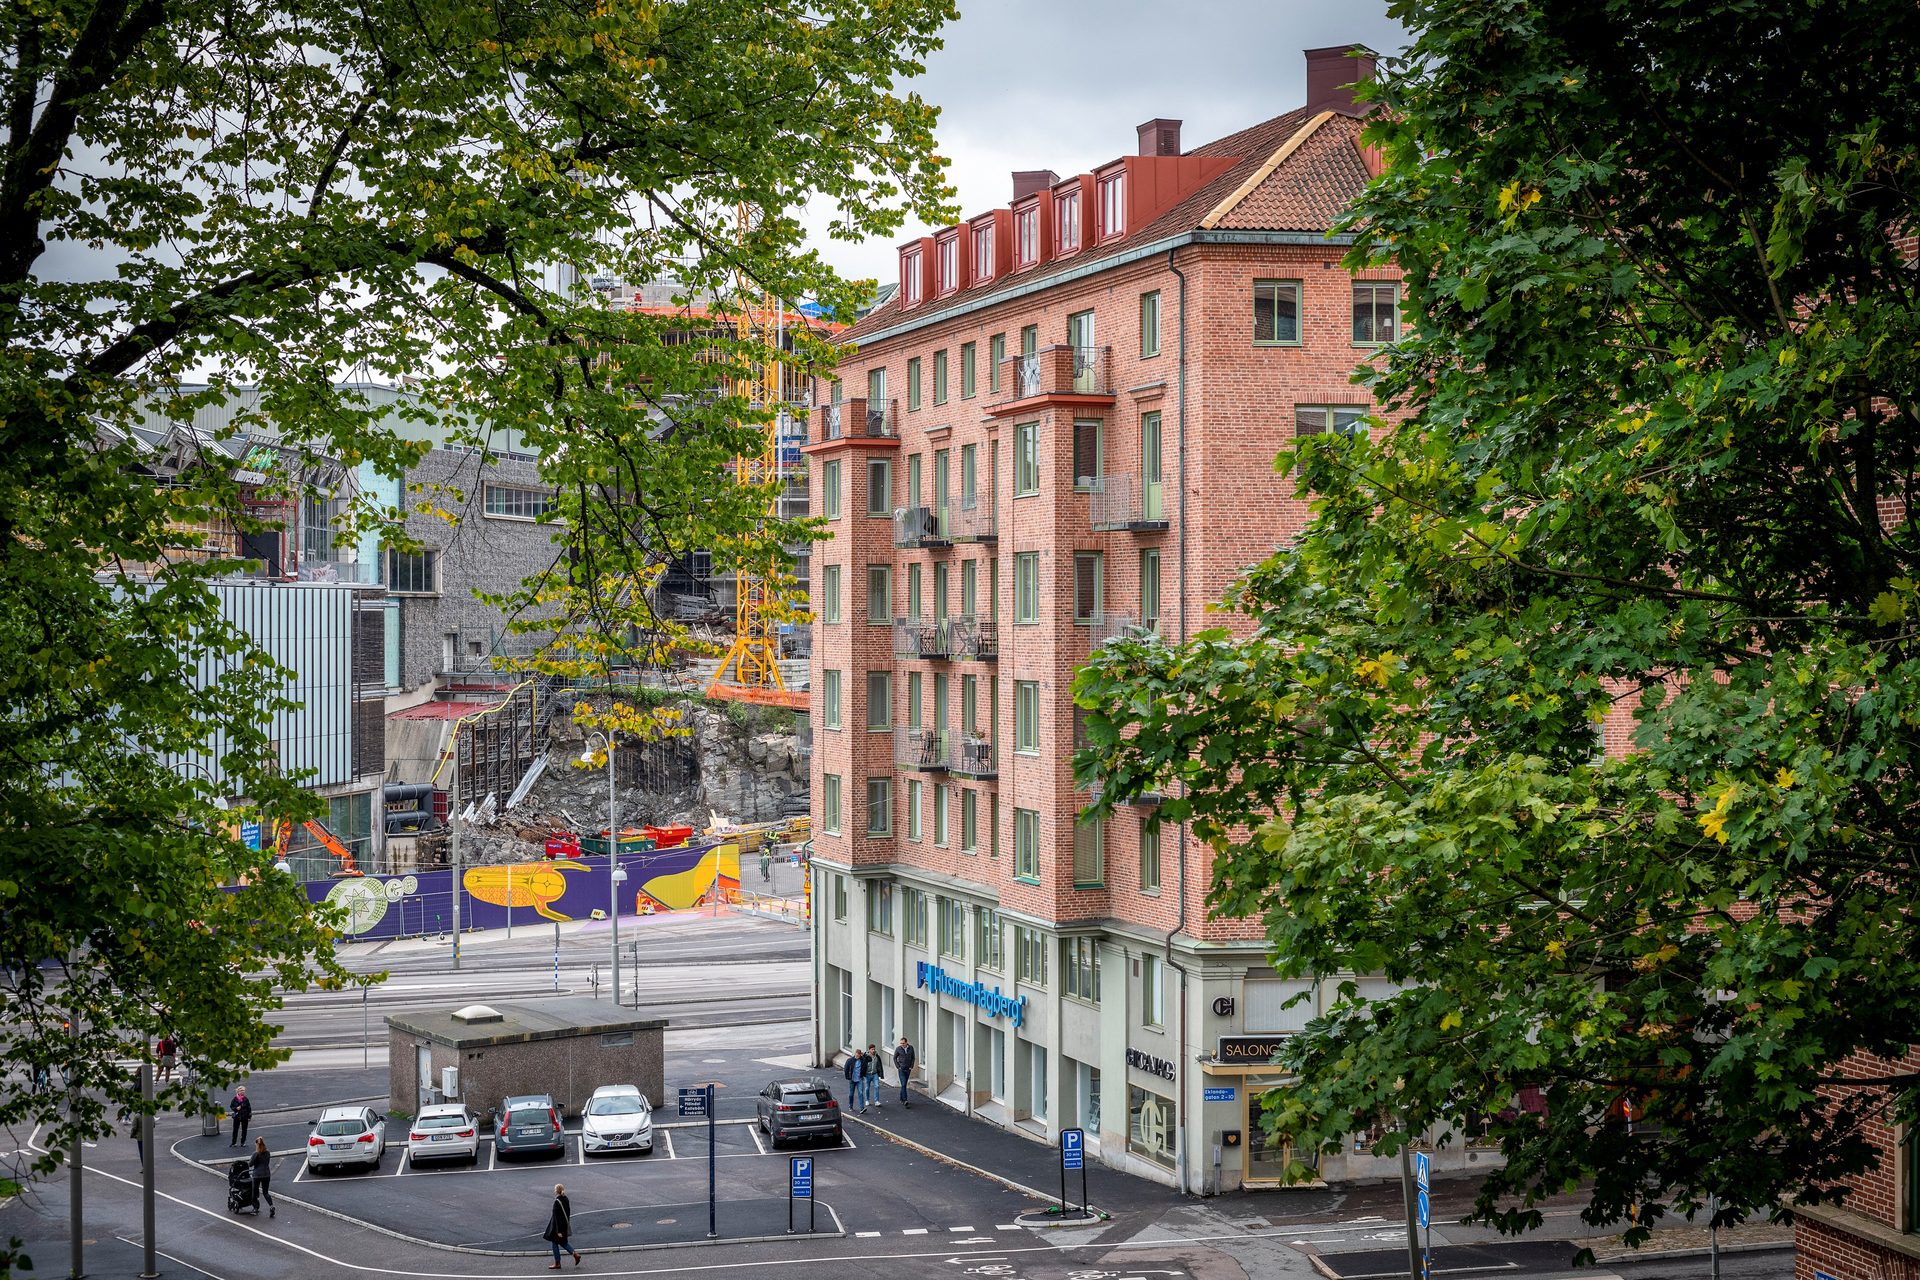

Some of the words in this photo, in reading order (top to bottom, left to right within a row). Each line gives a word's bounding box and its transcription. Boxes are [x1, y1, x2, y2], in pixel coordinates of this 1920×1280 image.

[935, 967, 1023, 1028] HusmanHagberg
[1067, 1132, 1079, 1149] P
[796, 1160, 808, 1177] P
